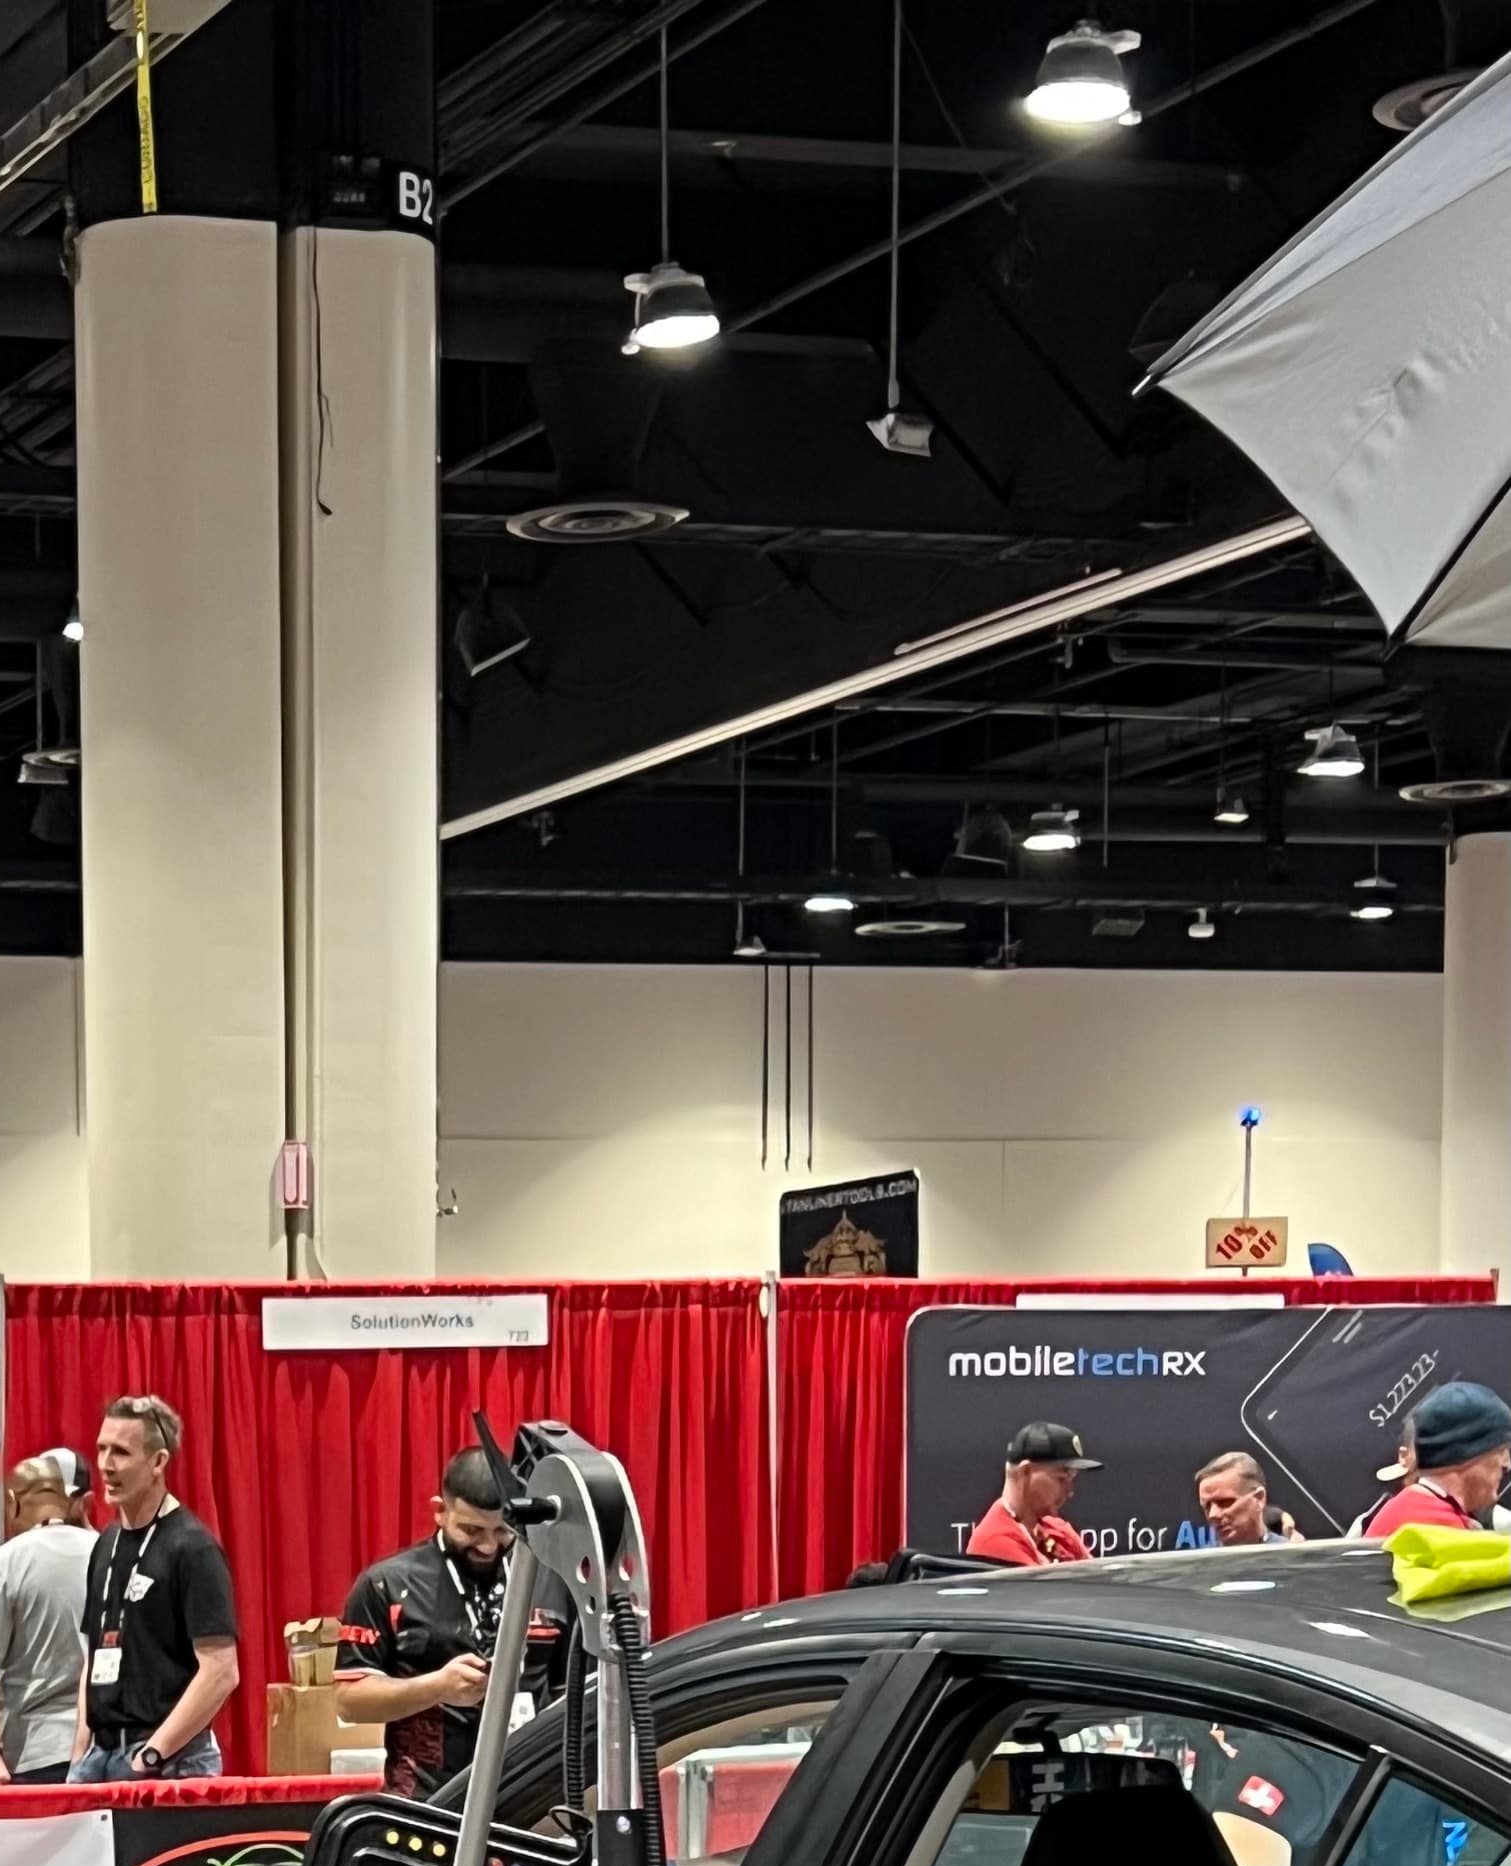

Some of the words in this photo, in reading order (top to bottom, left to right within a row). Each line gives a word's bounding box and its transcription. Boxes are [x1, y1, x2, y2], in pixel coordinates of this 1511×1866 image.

[398, 170, 434, 225] B2
[1216, 1225, 1258, 1260] 10%
[1249, 1229, 1278, 1260] OFF
[350, 1314, 475, 1331] SolutionWorks
[948, 1346, 1207, 1377] mobiletechRX
[1127, 1517, 1168, 1551] for
